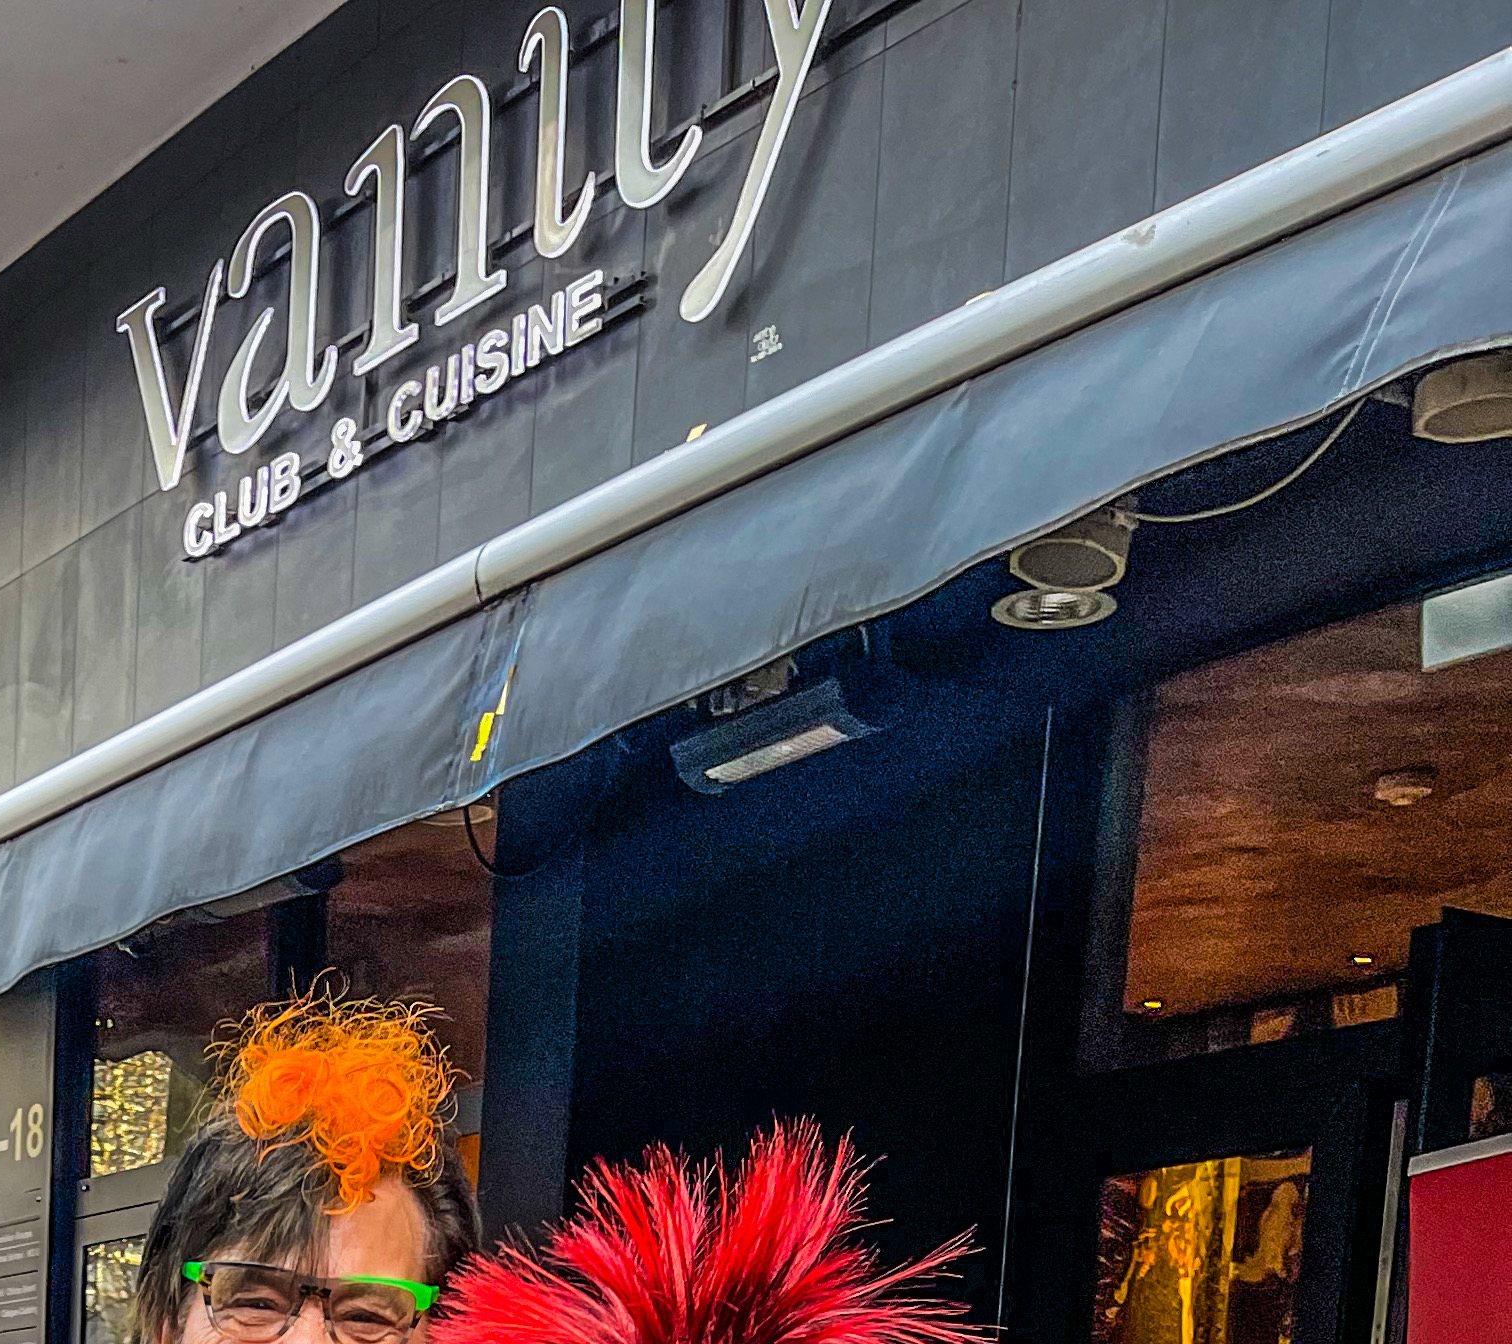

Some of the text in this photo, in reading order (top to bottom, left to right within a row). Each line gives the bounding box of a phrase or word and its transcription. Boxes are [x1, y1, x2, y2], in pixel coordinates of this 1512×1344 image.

[183, 269, 604, 558] CLUB & CUISINE
